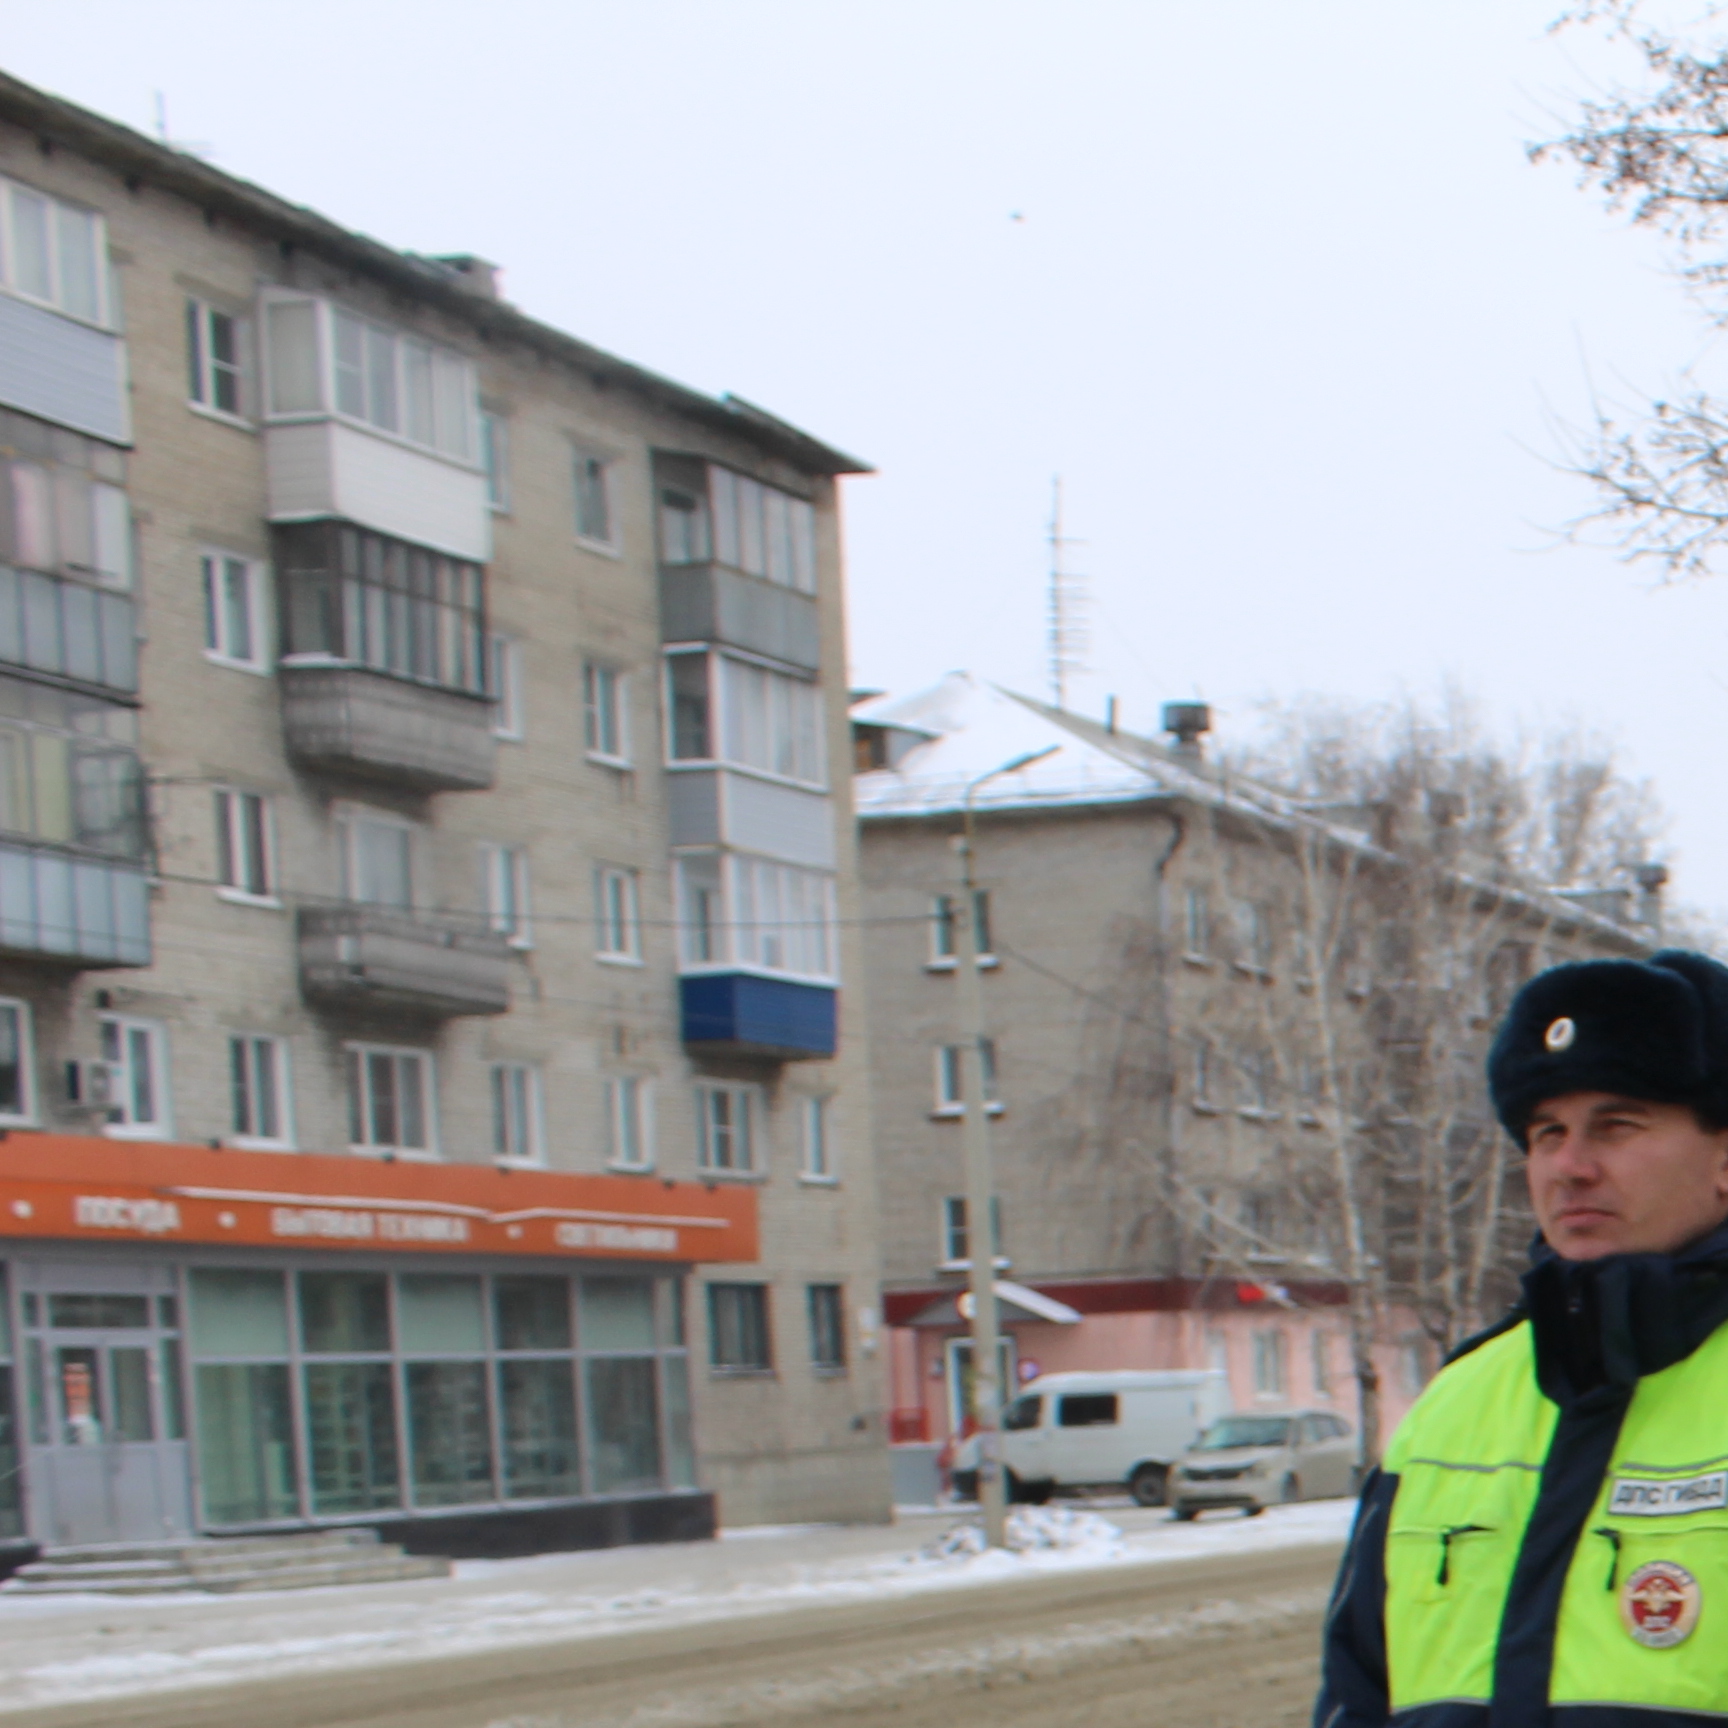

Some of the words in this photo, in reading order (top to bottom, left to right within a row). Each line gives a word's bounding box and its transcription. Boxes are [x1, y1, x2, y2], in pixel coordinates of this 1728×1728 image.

[74, 1196, 182, 1234] ПОСУДА
[271, 1206, 374, 1239] БЫТОВАЯ
[377, 1212, 470, 1242] ТЕХНИКА
